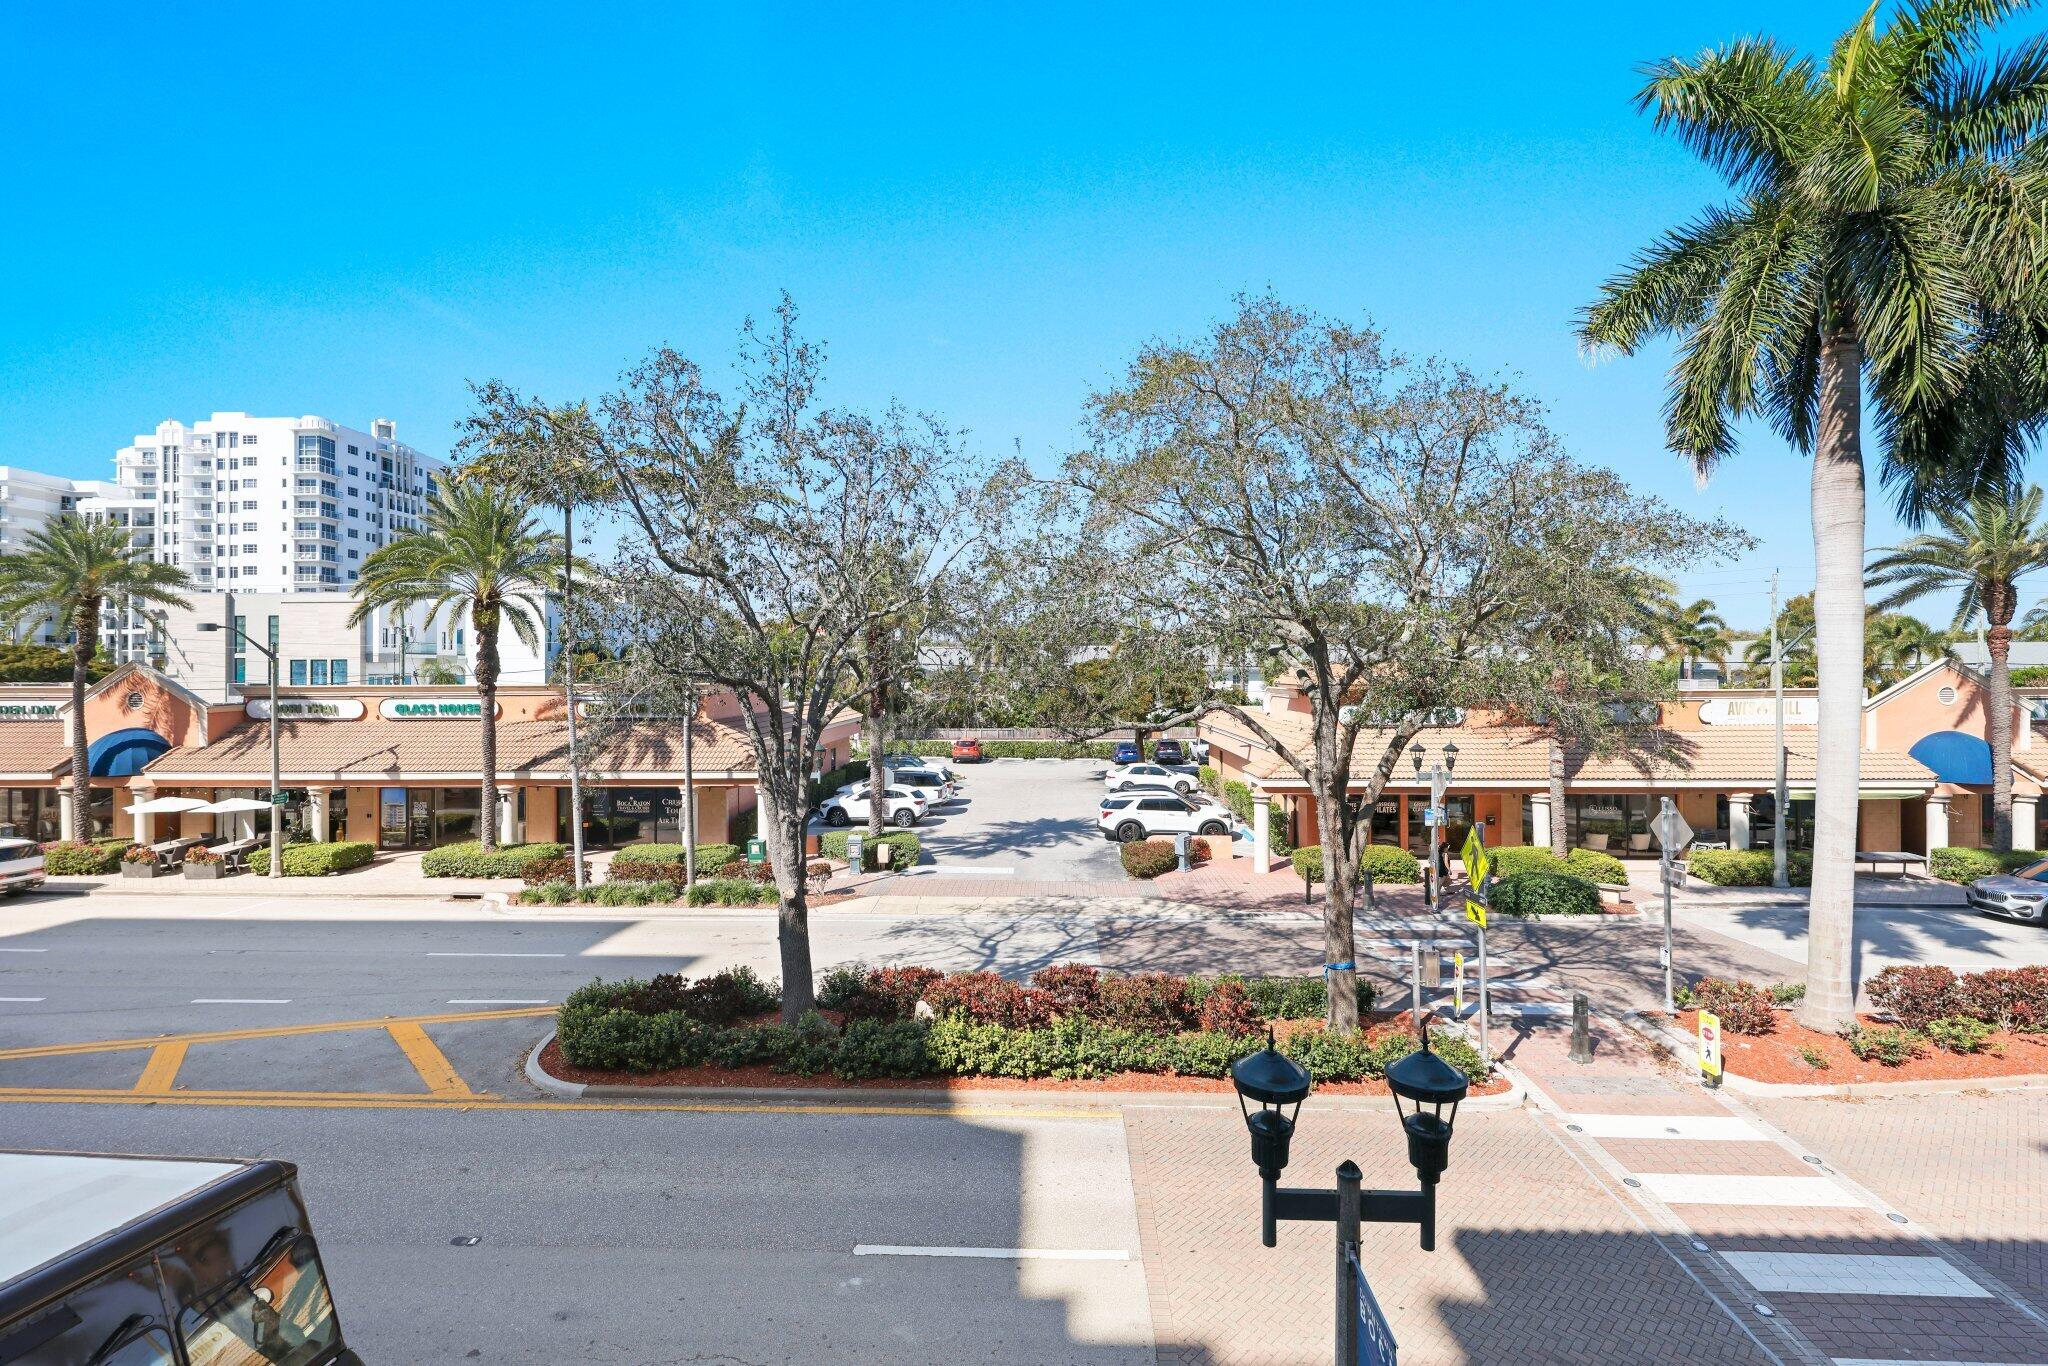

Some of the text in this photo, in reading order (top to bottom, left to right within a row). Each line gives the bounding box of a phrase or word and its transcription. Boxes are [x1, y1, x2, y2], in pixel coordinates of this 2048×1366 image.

[31, 705, 56, 714] DAY
[395, 704, 481, 714] GLASS HOUSE
[1360, 1300, 1393, 1366] BOC
